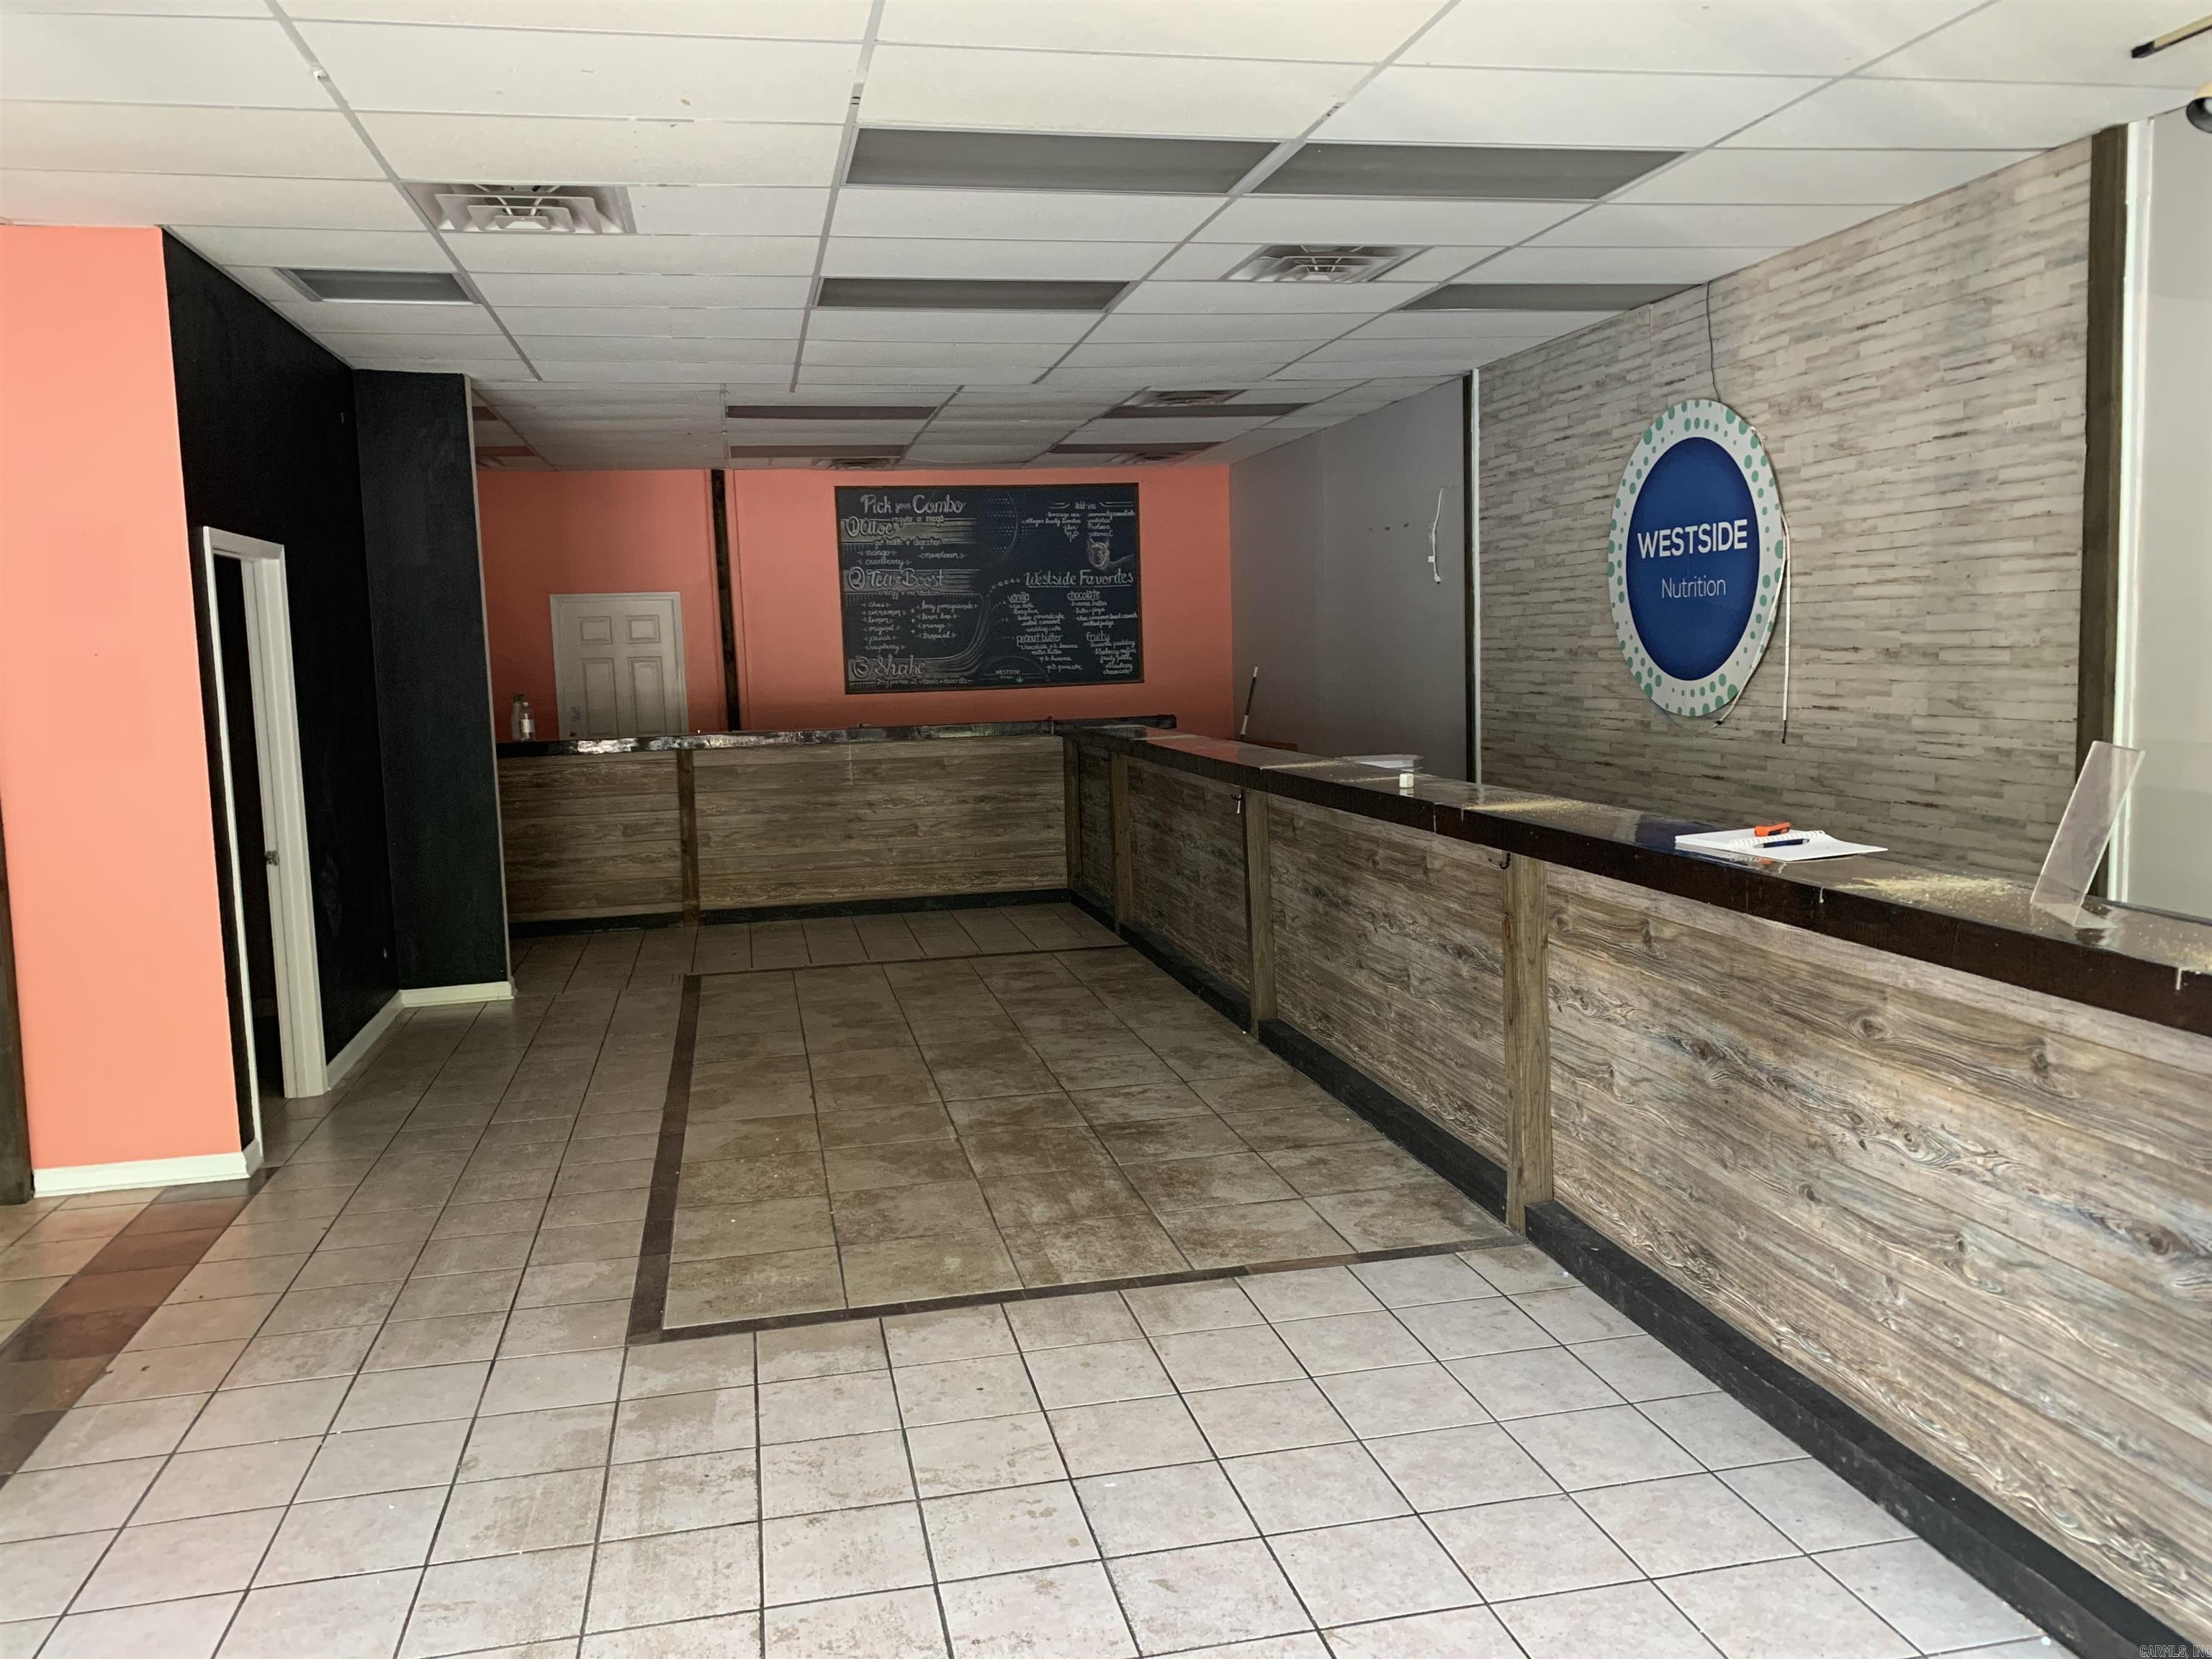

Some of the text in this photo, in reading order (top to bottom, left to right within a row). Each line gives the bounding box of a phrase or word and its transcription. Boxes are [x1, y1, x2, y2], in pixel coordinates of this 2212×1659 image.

[860, 494, 891, 513] Pick
[912, 494, 966, 513] Combo
[1074, 501, 1097, 510] add-ins
[860, 517, 894, 536] Aloe
[926, 515, 944, 526] mega
[886, 538, 903, 547] health
[912, 537, 942, 550] digestion
[1637, 518, 1748, 559] WESTSIDE
[866, 549, 891, 559] mango
[866, 570, 894, 588] Tea
[902, 568, 945, 588] Boost
[1023, 568, 1134, 586] Westside Favorites
[1067, 589, 1101, 601] chocolate
[1661, 576, 1727, 600] Nutrition
[1007, 591, 1030, 603] vanilla
[923, 631, 950, 641] tropical
[1016, 632, 1064, 647] peanut butter
[1085, 630, 1110, 642] fruity
[874, 653, 926, 677] Shake
